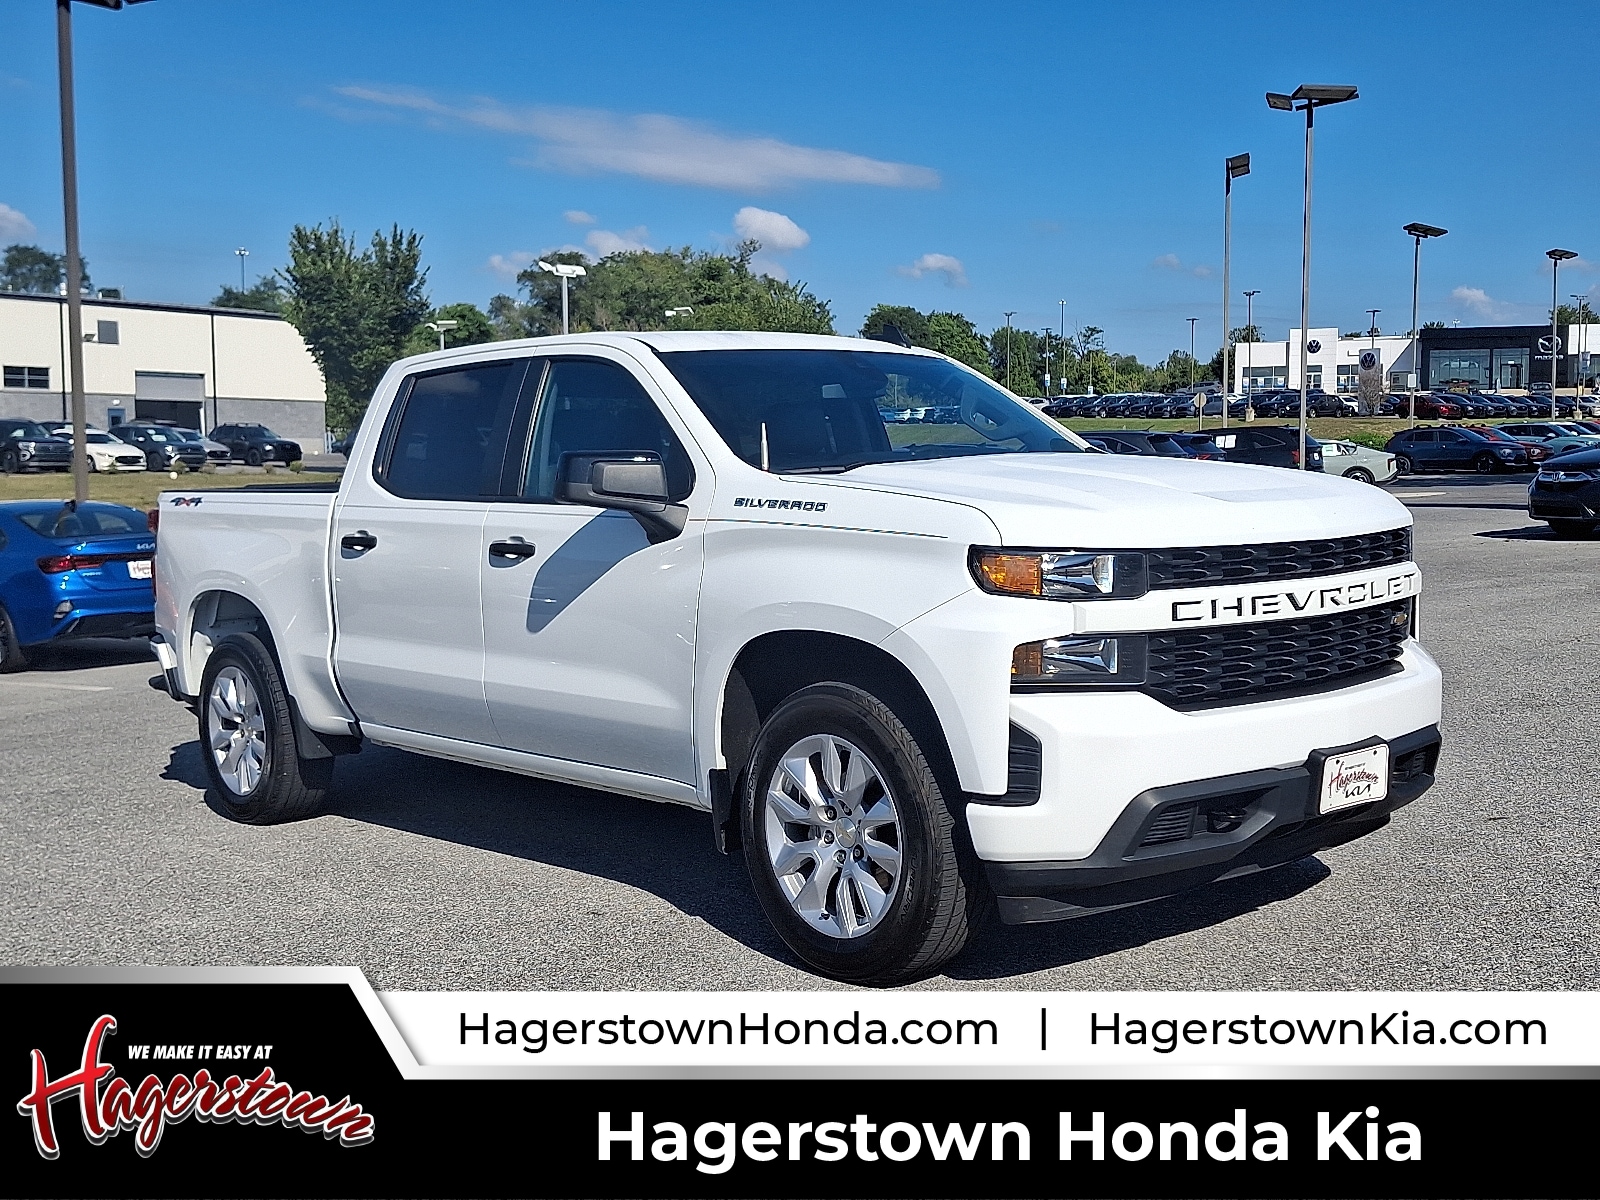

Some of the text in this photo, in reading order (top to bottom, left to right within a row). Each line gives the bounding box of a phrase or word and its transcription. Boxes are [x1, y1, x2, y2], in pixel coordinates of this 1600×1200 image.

[734, 498, 828, 512] SILVERADO
[1172, 572, 1418, 622] CHEVROLET
[1345, 784, 1371, 798] KIA
